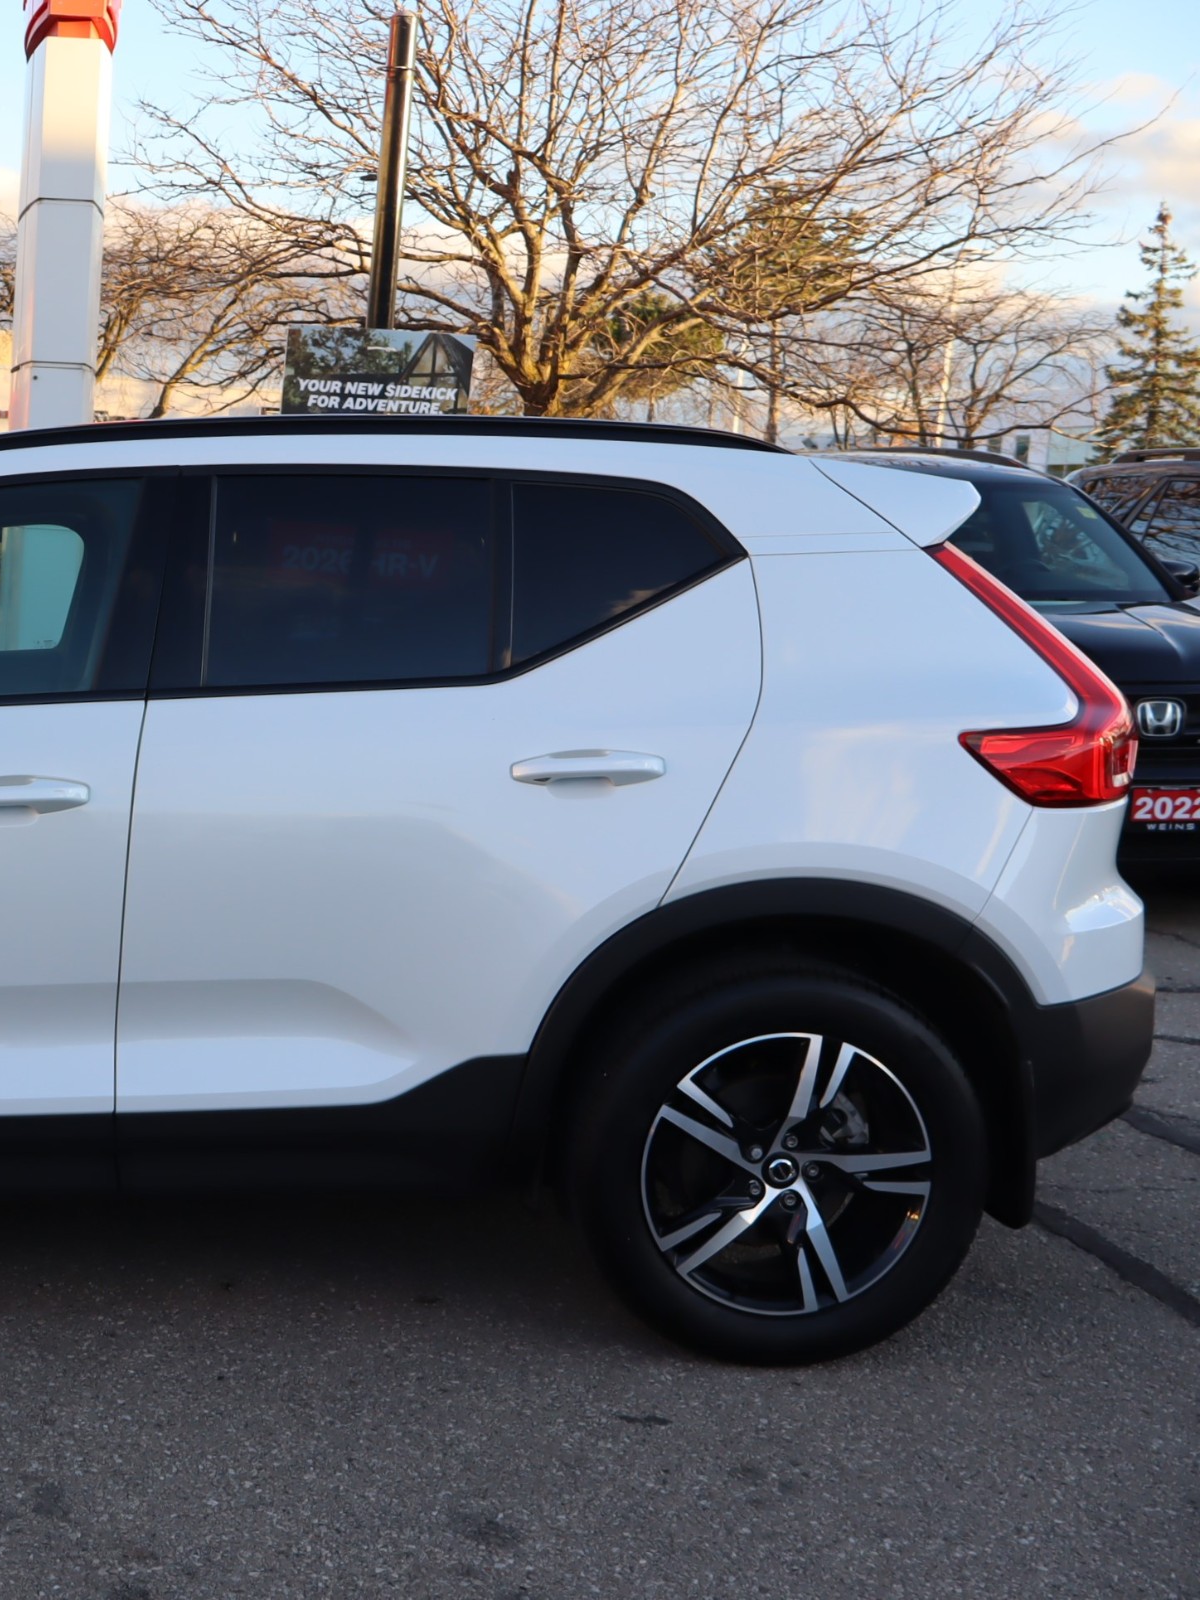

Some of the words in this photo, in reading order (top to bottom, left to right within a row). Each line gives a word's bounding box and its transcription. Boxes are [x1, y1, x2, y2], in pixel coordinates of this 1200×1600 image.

[298, 377, 343, 394] YOUR
[344, 380, 384, 396] NEW
[384, 382, 459, 401] SIDEKICK
[307, 394, 341, 409] FOR
[342, 396, 444, 415] ADVENTURE.
[1146, 823, 1196, 831] WEINS
